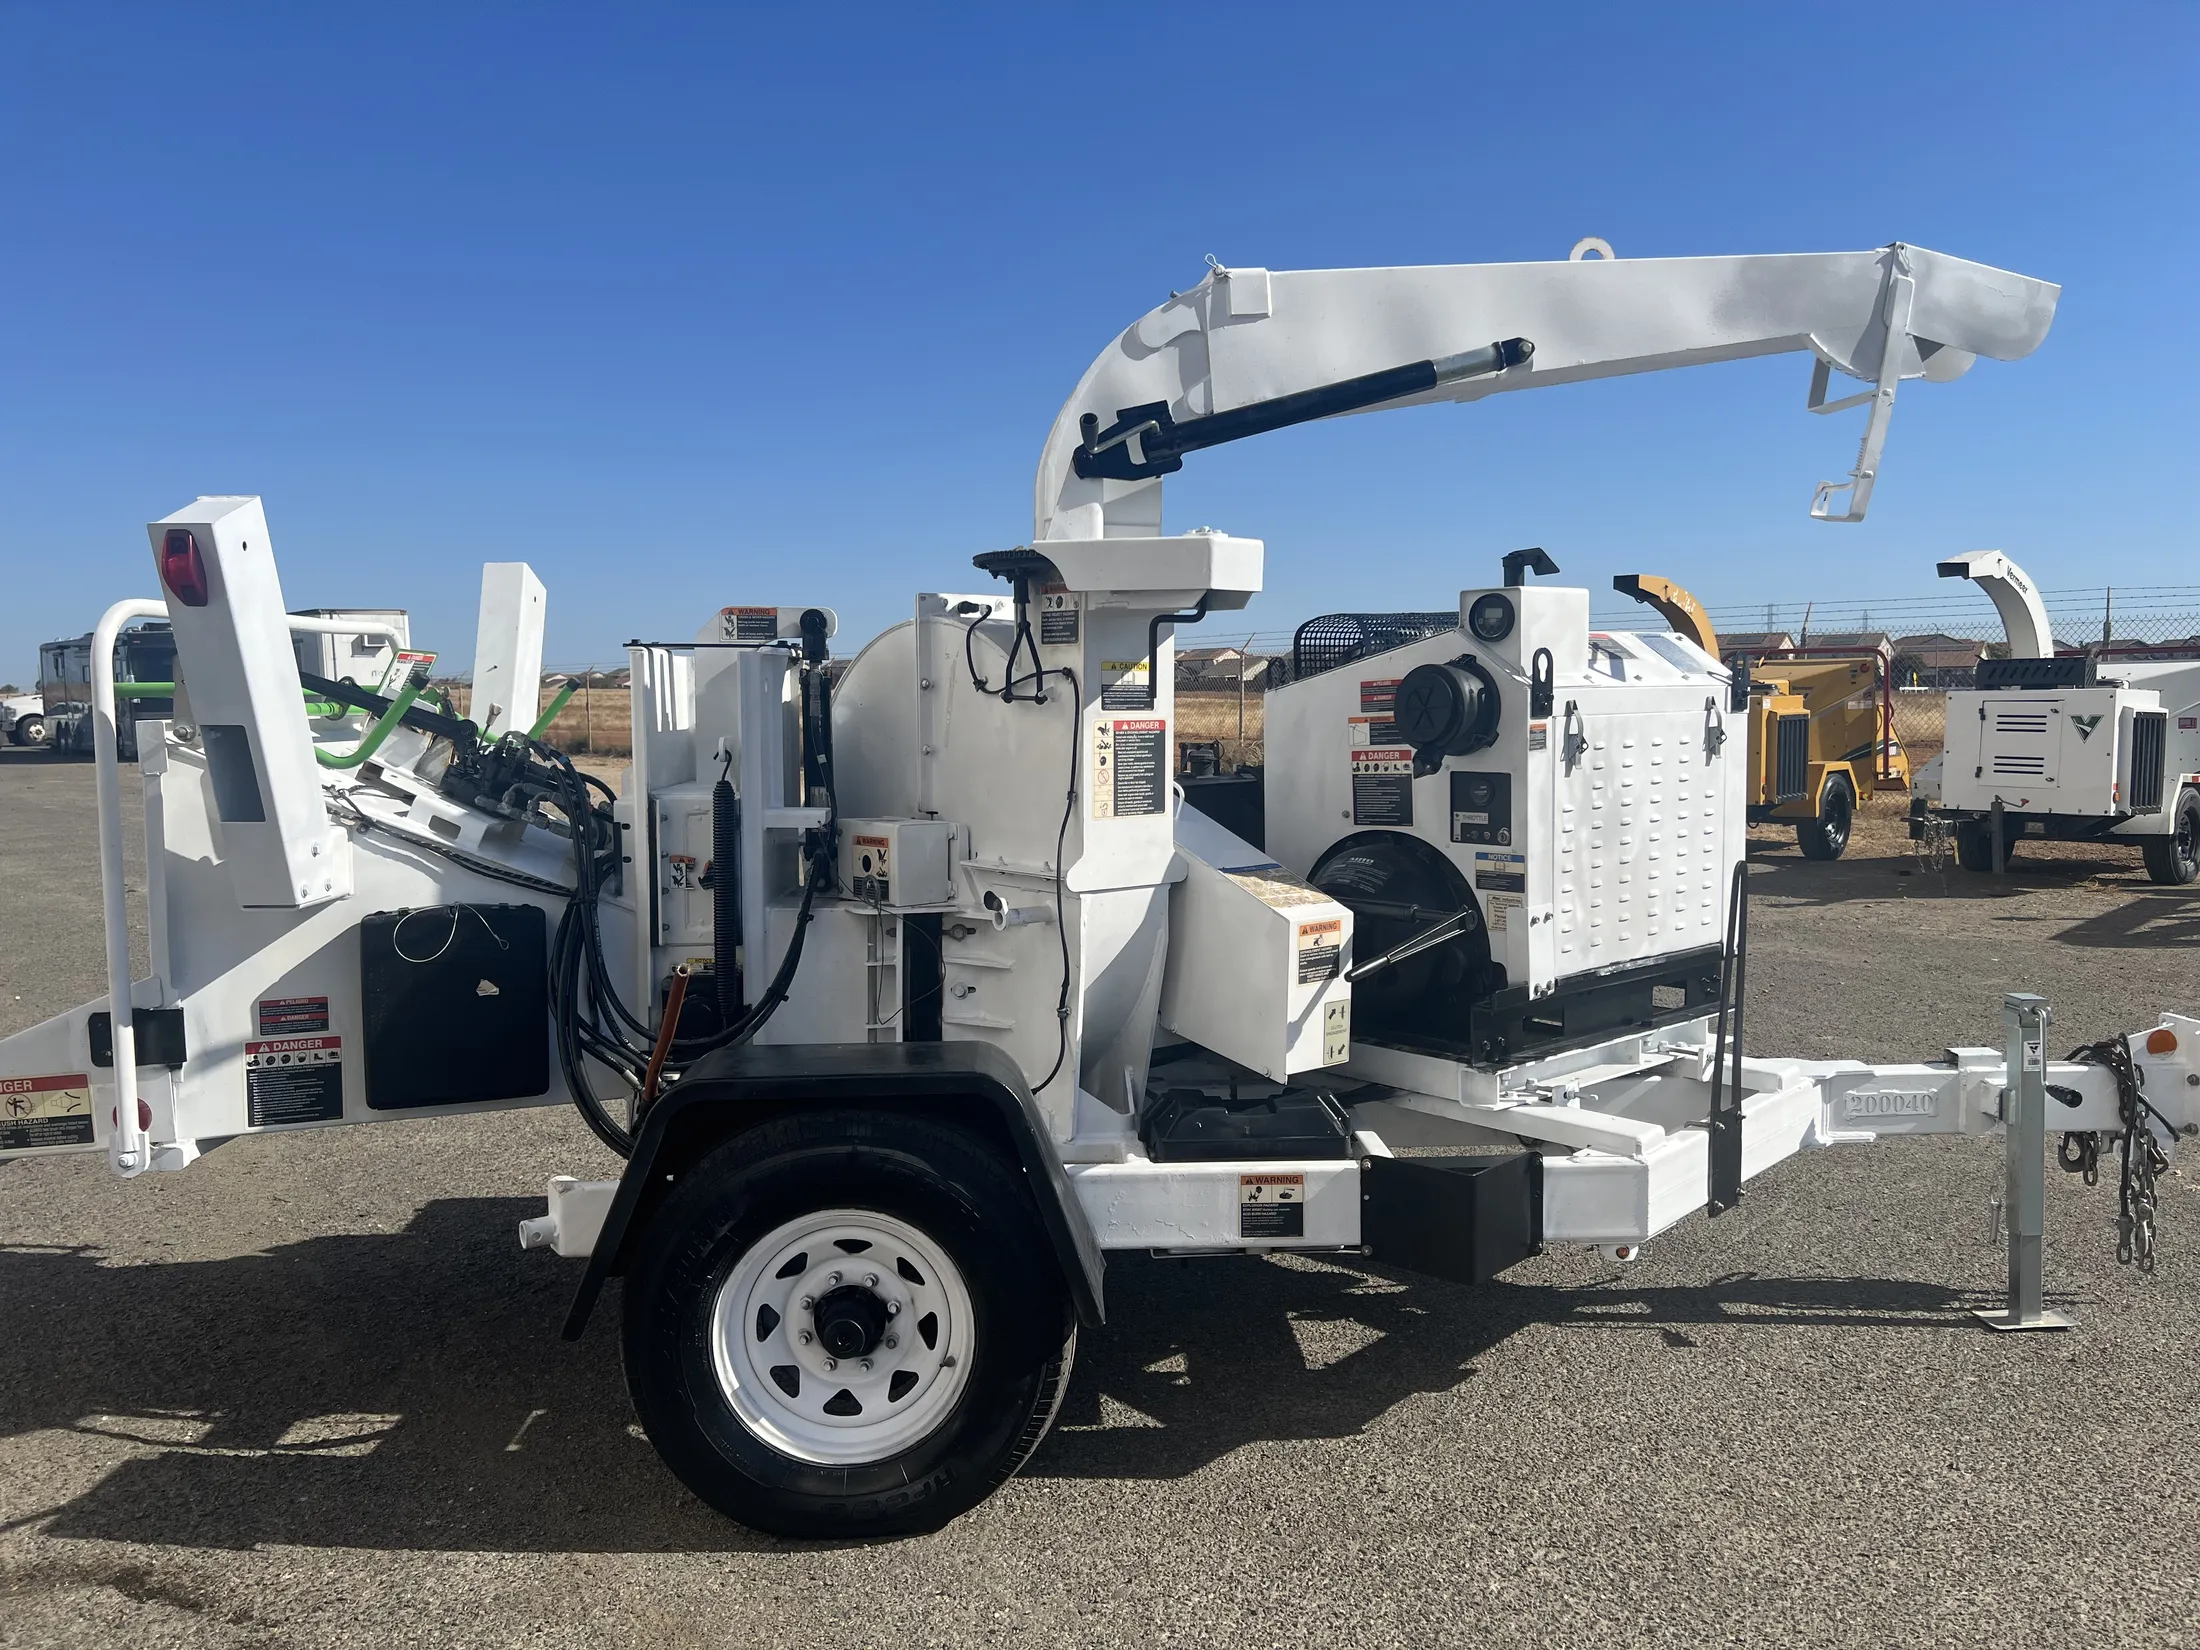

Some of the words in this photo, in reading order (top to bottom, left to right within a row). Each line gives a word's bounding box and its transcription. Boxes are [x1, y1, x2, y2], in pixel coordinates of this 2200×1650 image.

[2006, 564, 2028, 595] Vermeer
[1130, 721, 1160, 730] DANGER
[1368, 751, 1400, 760] DANGER
[862, 837, 885, 846] WARNING
[1309, 923, 1338, 933] WARNING
[273, 1039, 323, 1051] DANGER
[1850, 1095, 1933, 1113] 200040
[18, 1117, 49, 1126] HAZARD
[1255, 1176, 1299, 1184] WARNING
